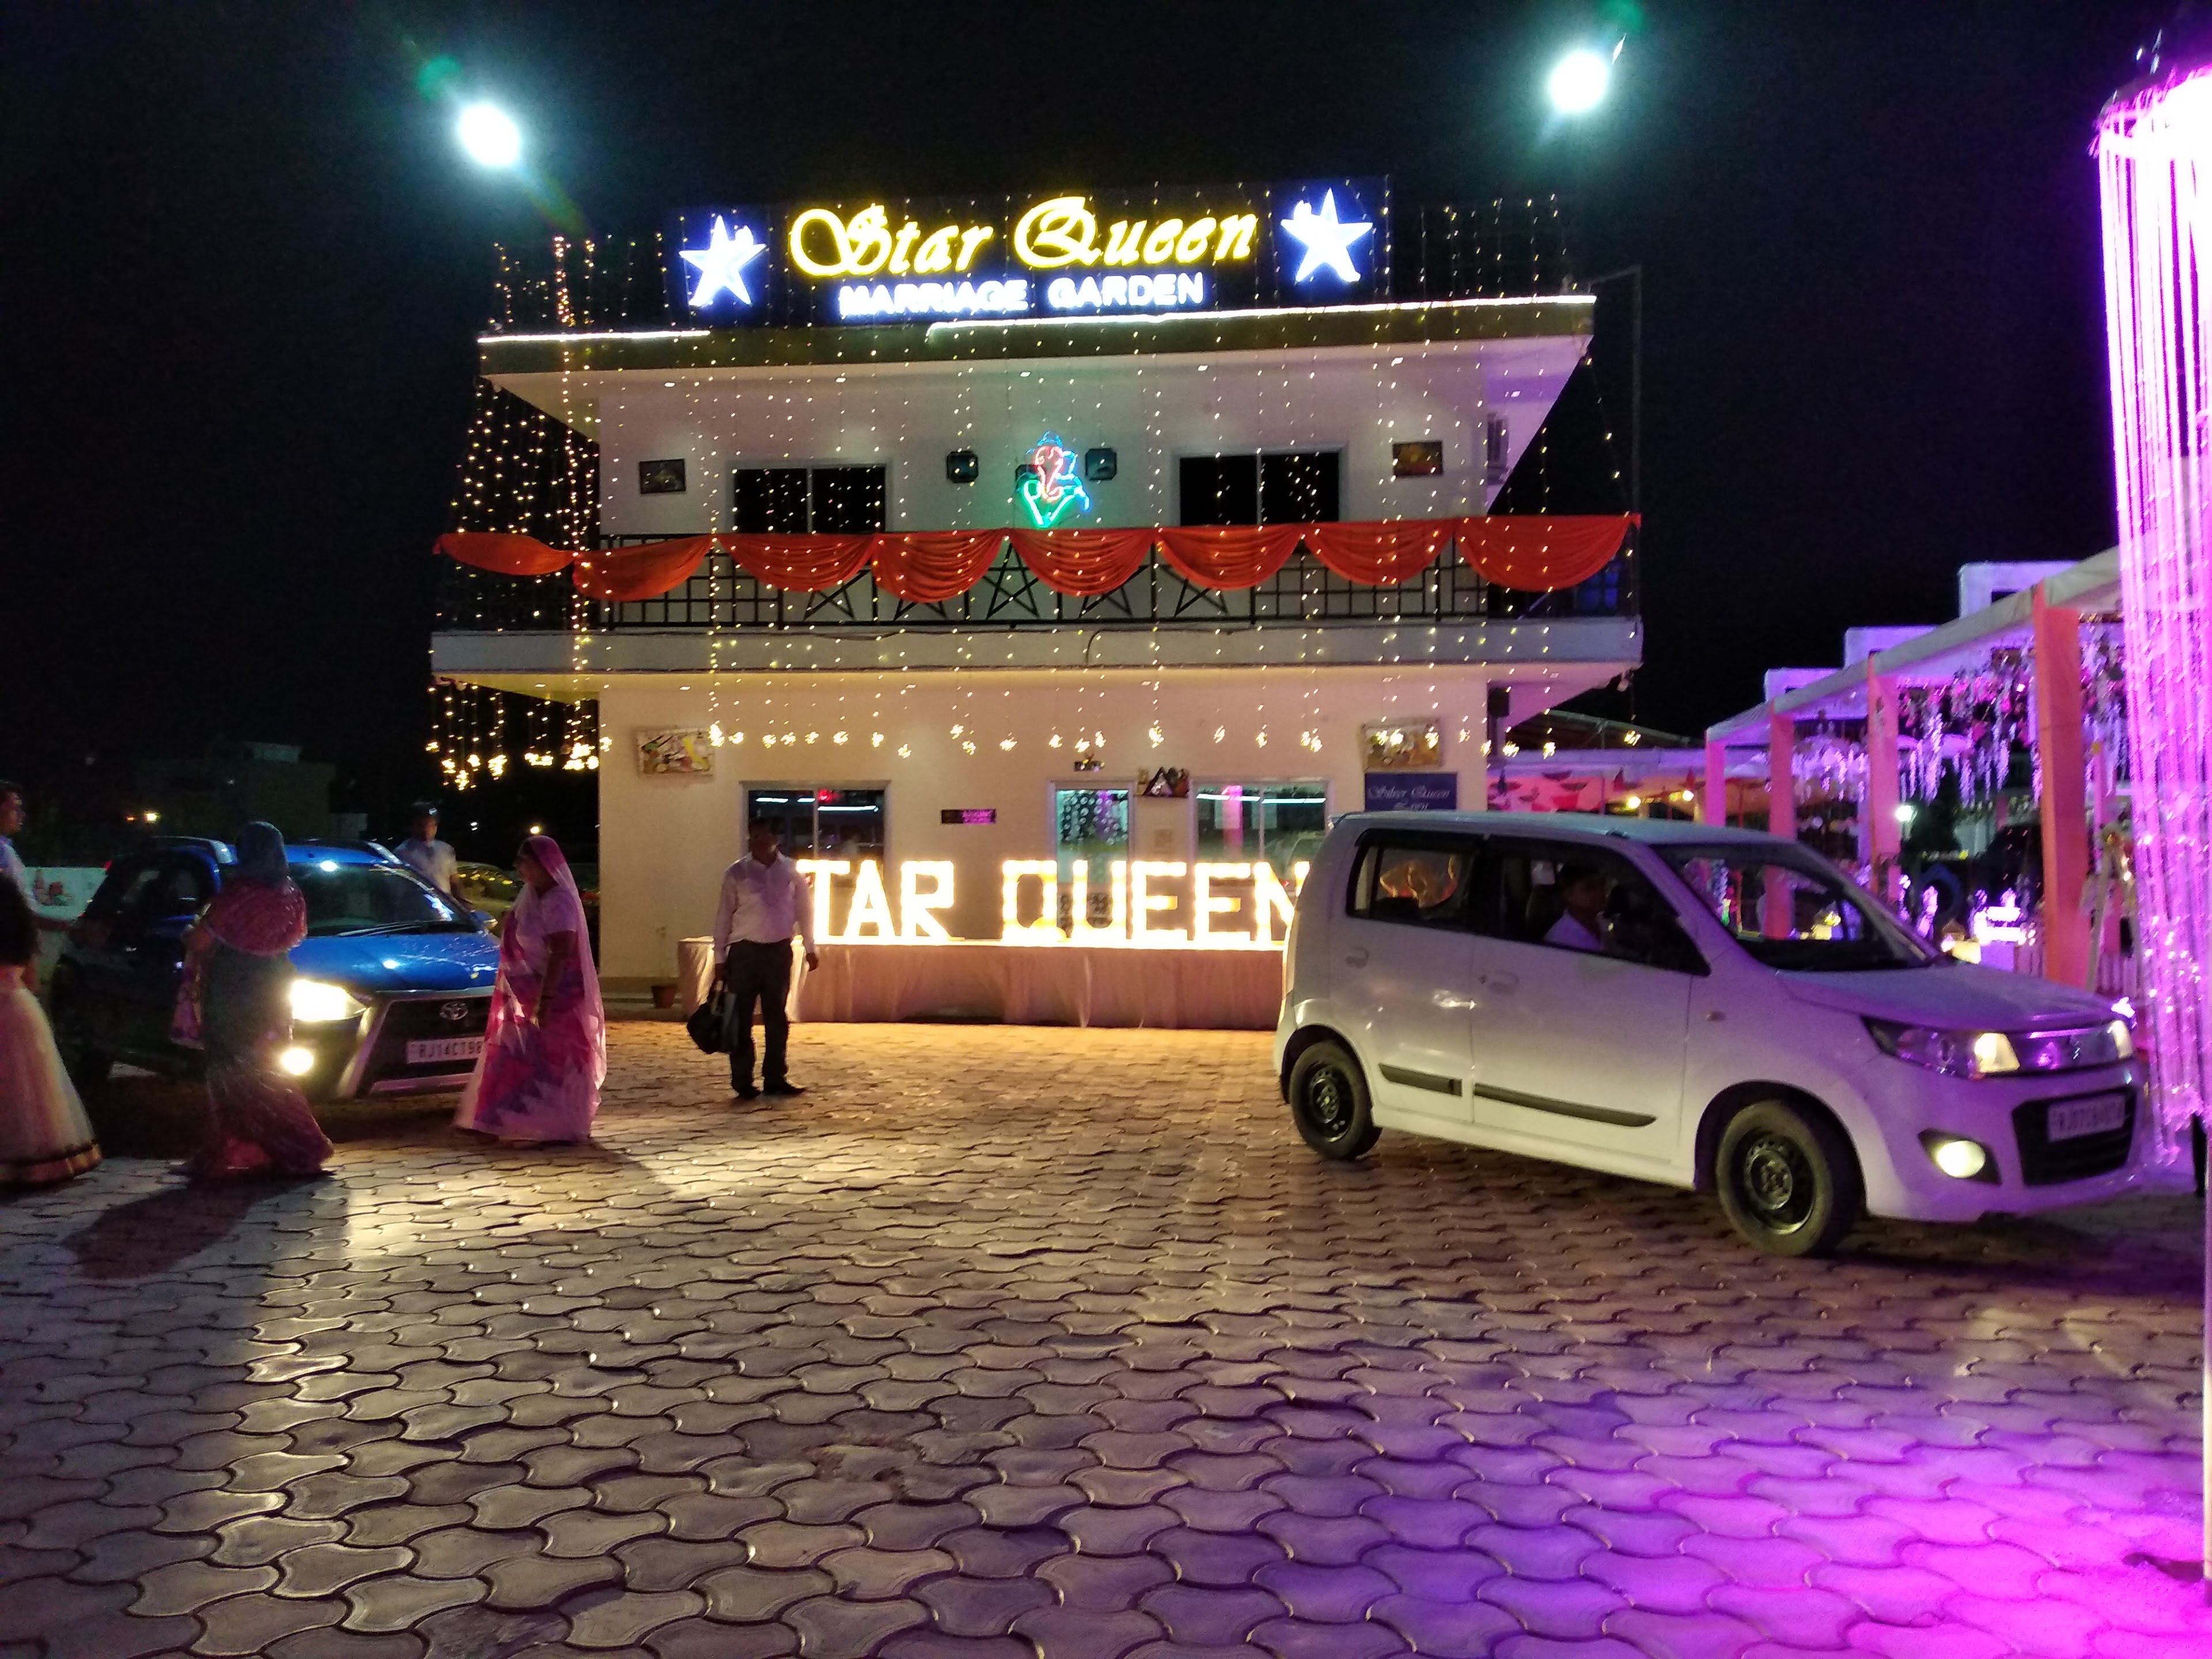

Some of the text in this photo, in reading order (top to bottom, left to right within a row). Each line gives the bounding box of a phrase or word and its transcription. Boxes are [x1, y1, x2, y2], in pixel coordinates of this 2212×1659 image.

[790, 196, 1258, 275] Star Queen
[839, 271, 1203, 316] MARRIAGE GARDEN
[1411, 785, 1450, 798] Queen
[796, 859, 1310, 946] TAR QUEEN
[419, 1041, 483, 1058] RJ14CT98
